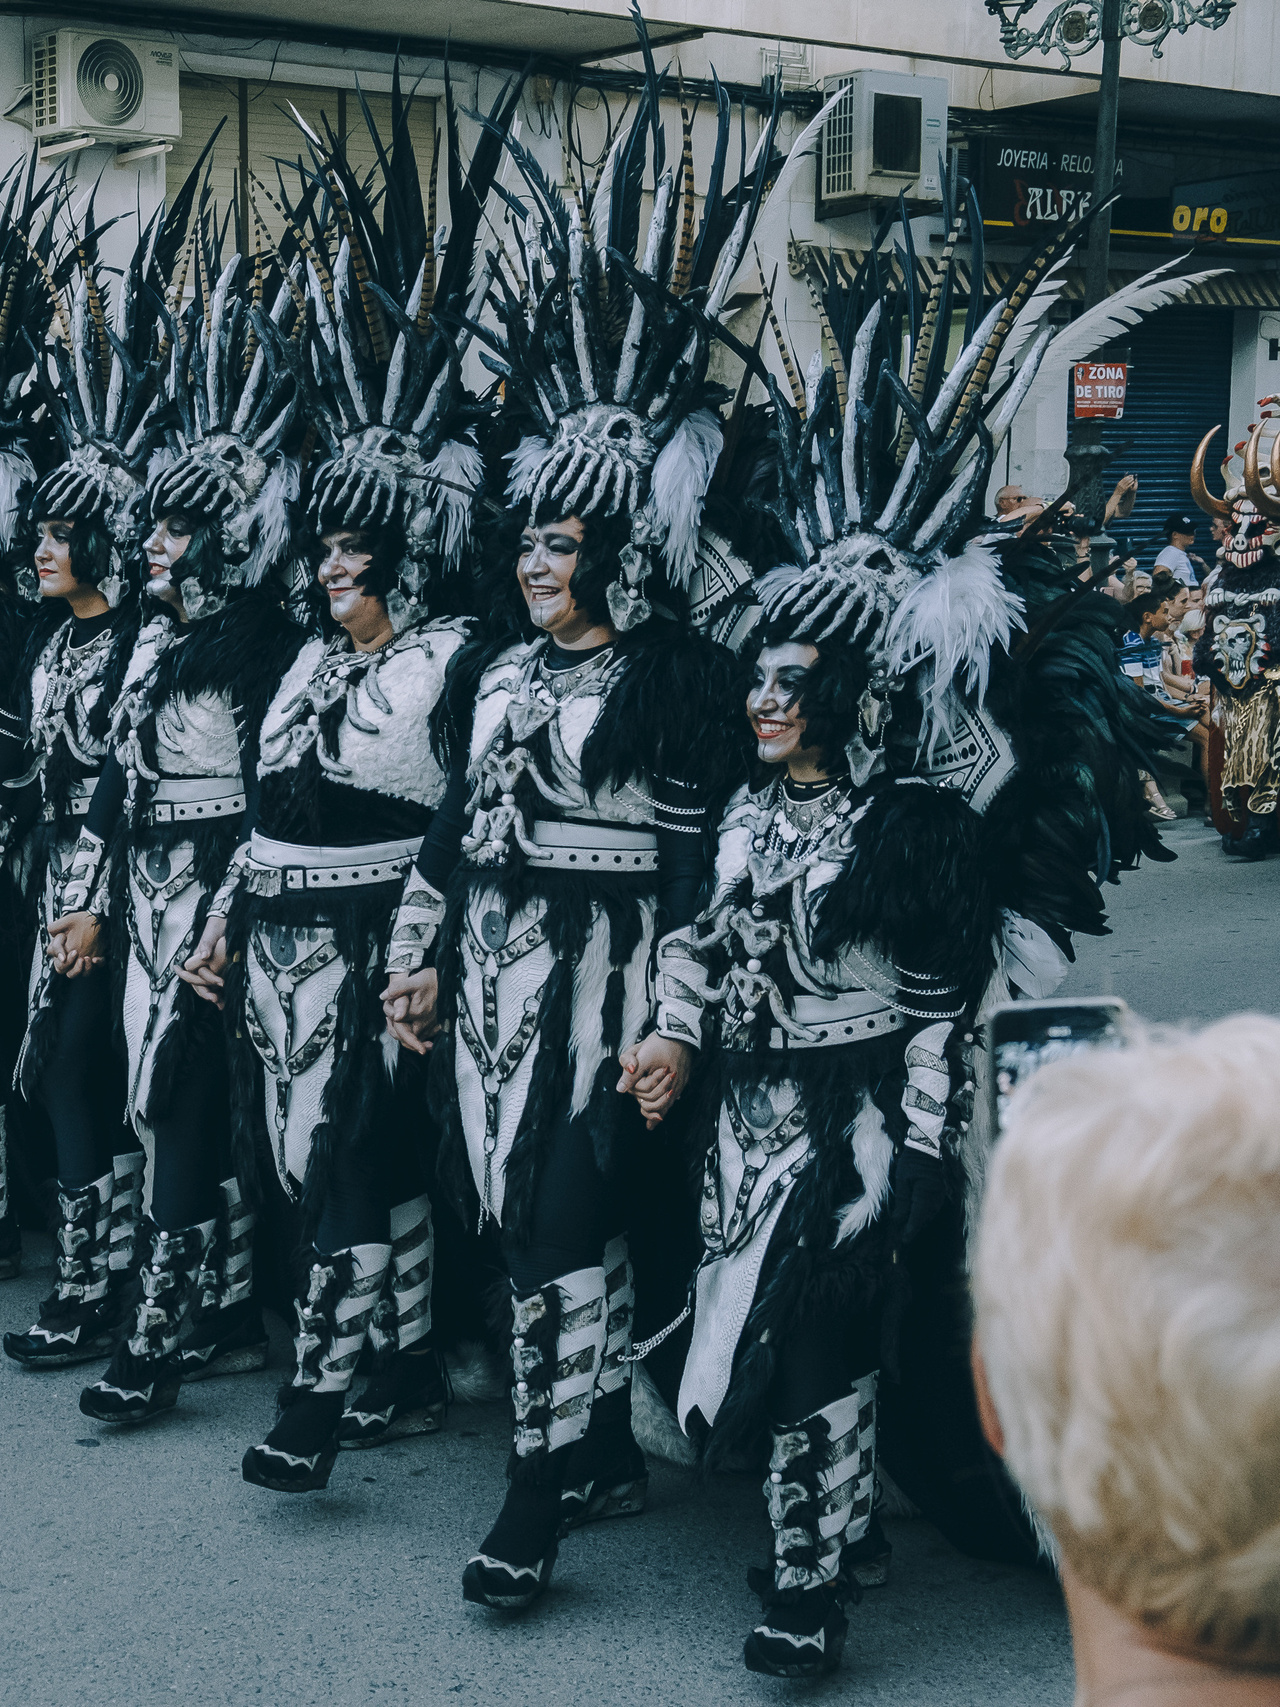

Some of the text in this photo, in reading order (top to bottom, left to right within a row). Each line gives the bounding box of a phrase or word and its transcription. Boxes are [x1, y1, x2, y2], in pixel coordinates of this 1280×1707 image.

[997, 148, 1048, 170] JOYERIA
[1060, 153, 1123, 176] RELOA
[1173, 205, 1228, 233] oro
[1088, 366, 1124, 380] ZONA
[1076, 385, 1124, 399] DE TIRO
